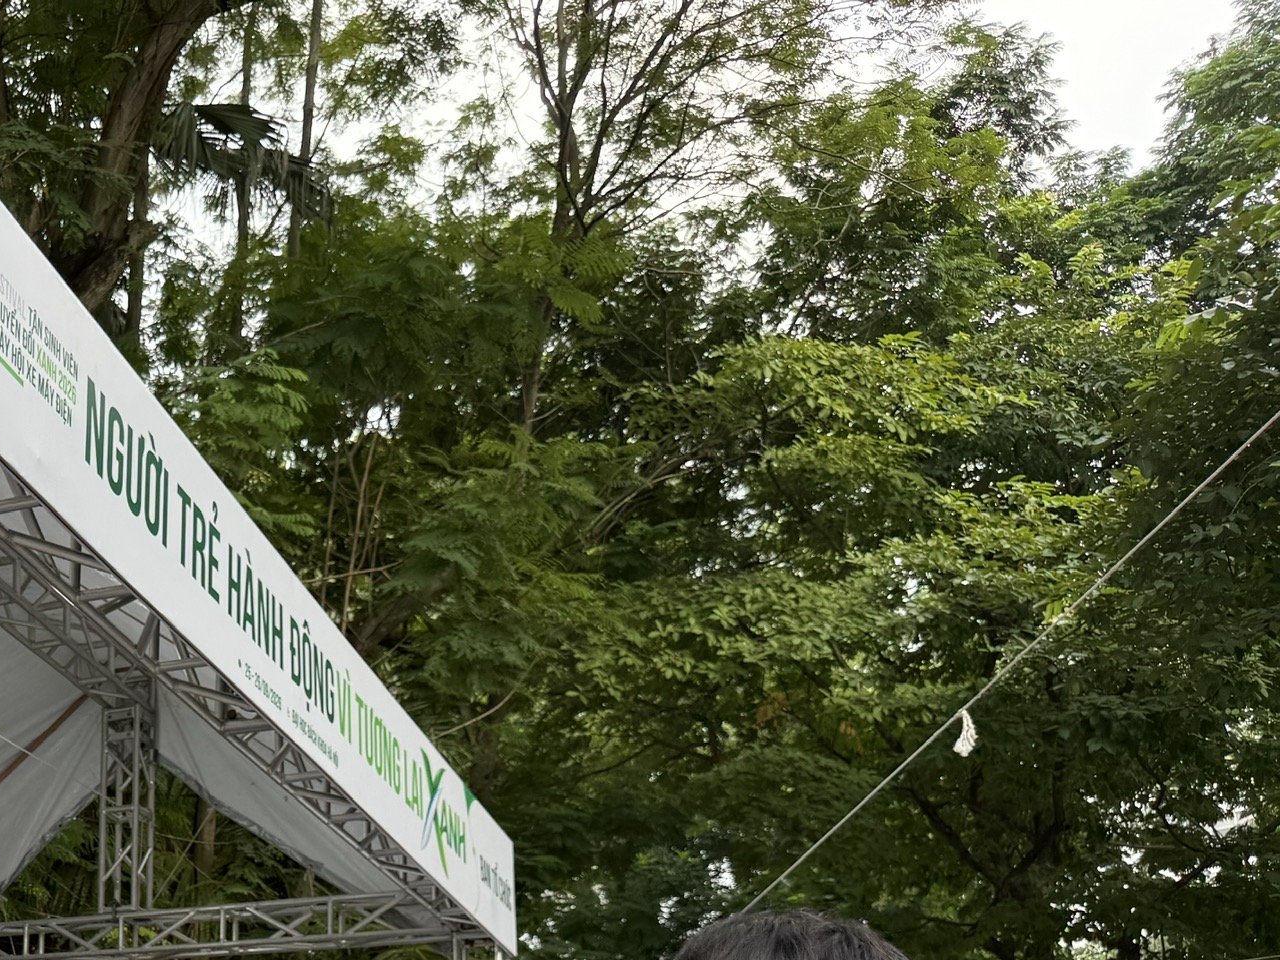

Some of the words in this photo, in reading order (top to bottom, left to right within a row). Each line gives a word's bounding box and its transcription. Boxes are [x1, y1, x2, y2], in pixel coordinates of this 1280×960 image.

[28, 305, 43, 339] TÂN
[44, 326, 61, 358] SINH
[62, 347, 79, 382] VIÊN
[36, 343, 57, 383] XANH
[58, 369, 77, 405] 2026
[11, 343, 25, 376] HỘI
[26, 359, 37, 388] XE
[38, 373, 55, 407] MÁY
[55, 392, 73, 427] ĐIỆN
[85, 375, 169, 549] NGƯỜI
[177, 482, 221, 605] TRẺ
[227, 543, 284, 671] HÀNH
[290, 614, 335, 724] ĐỘNG
[336, 668, 352, 745] VÌ
[355, 693, 401, 796] TƯƠNG
[404, 749, 423, 821] LAI
